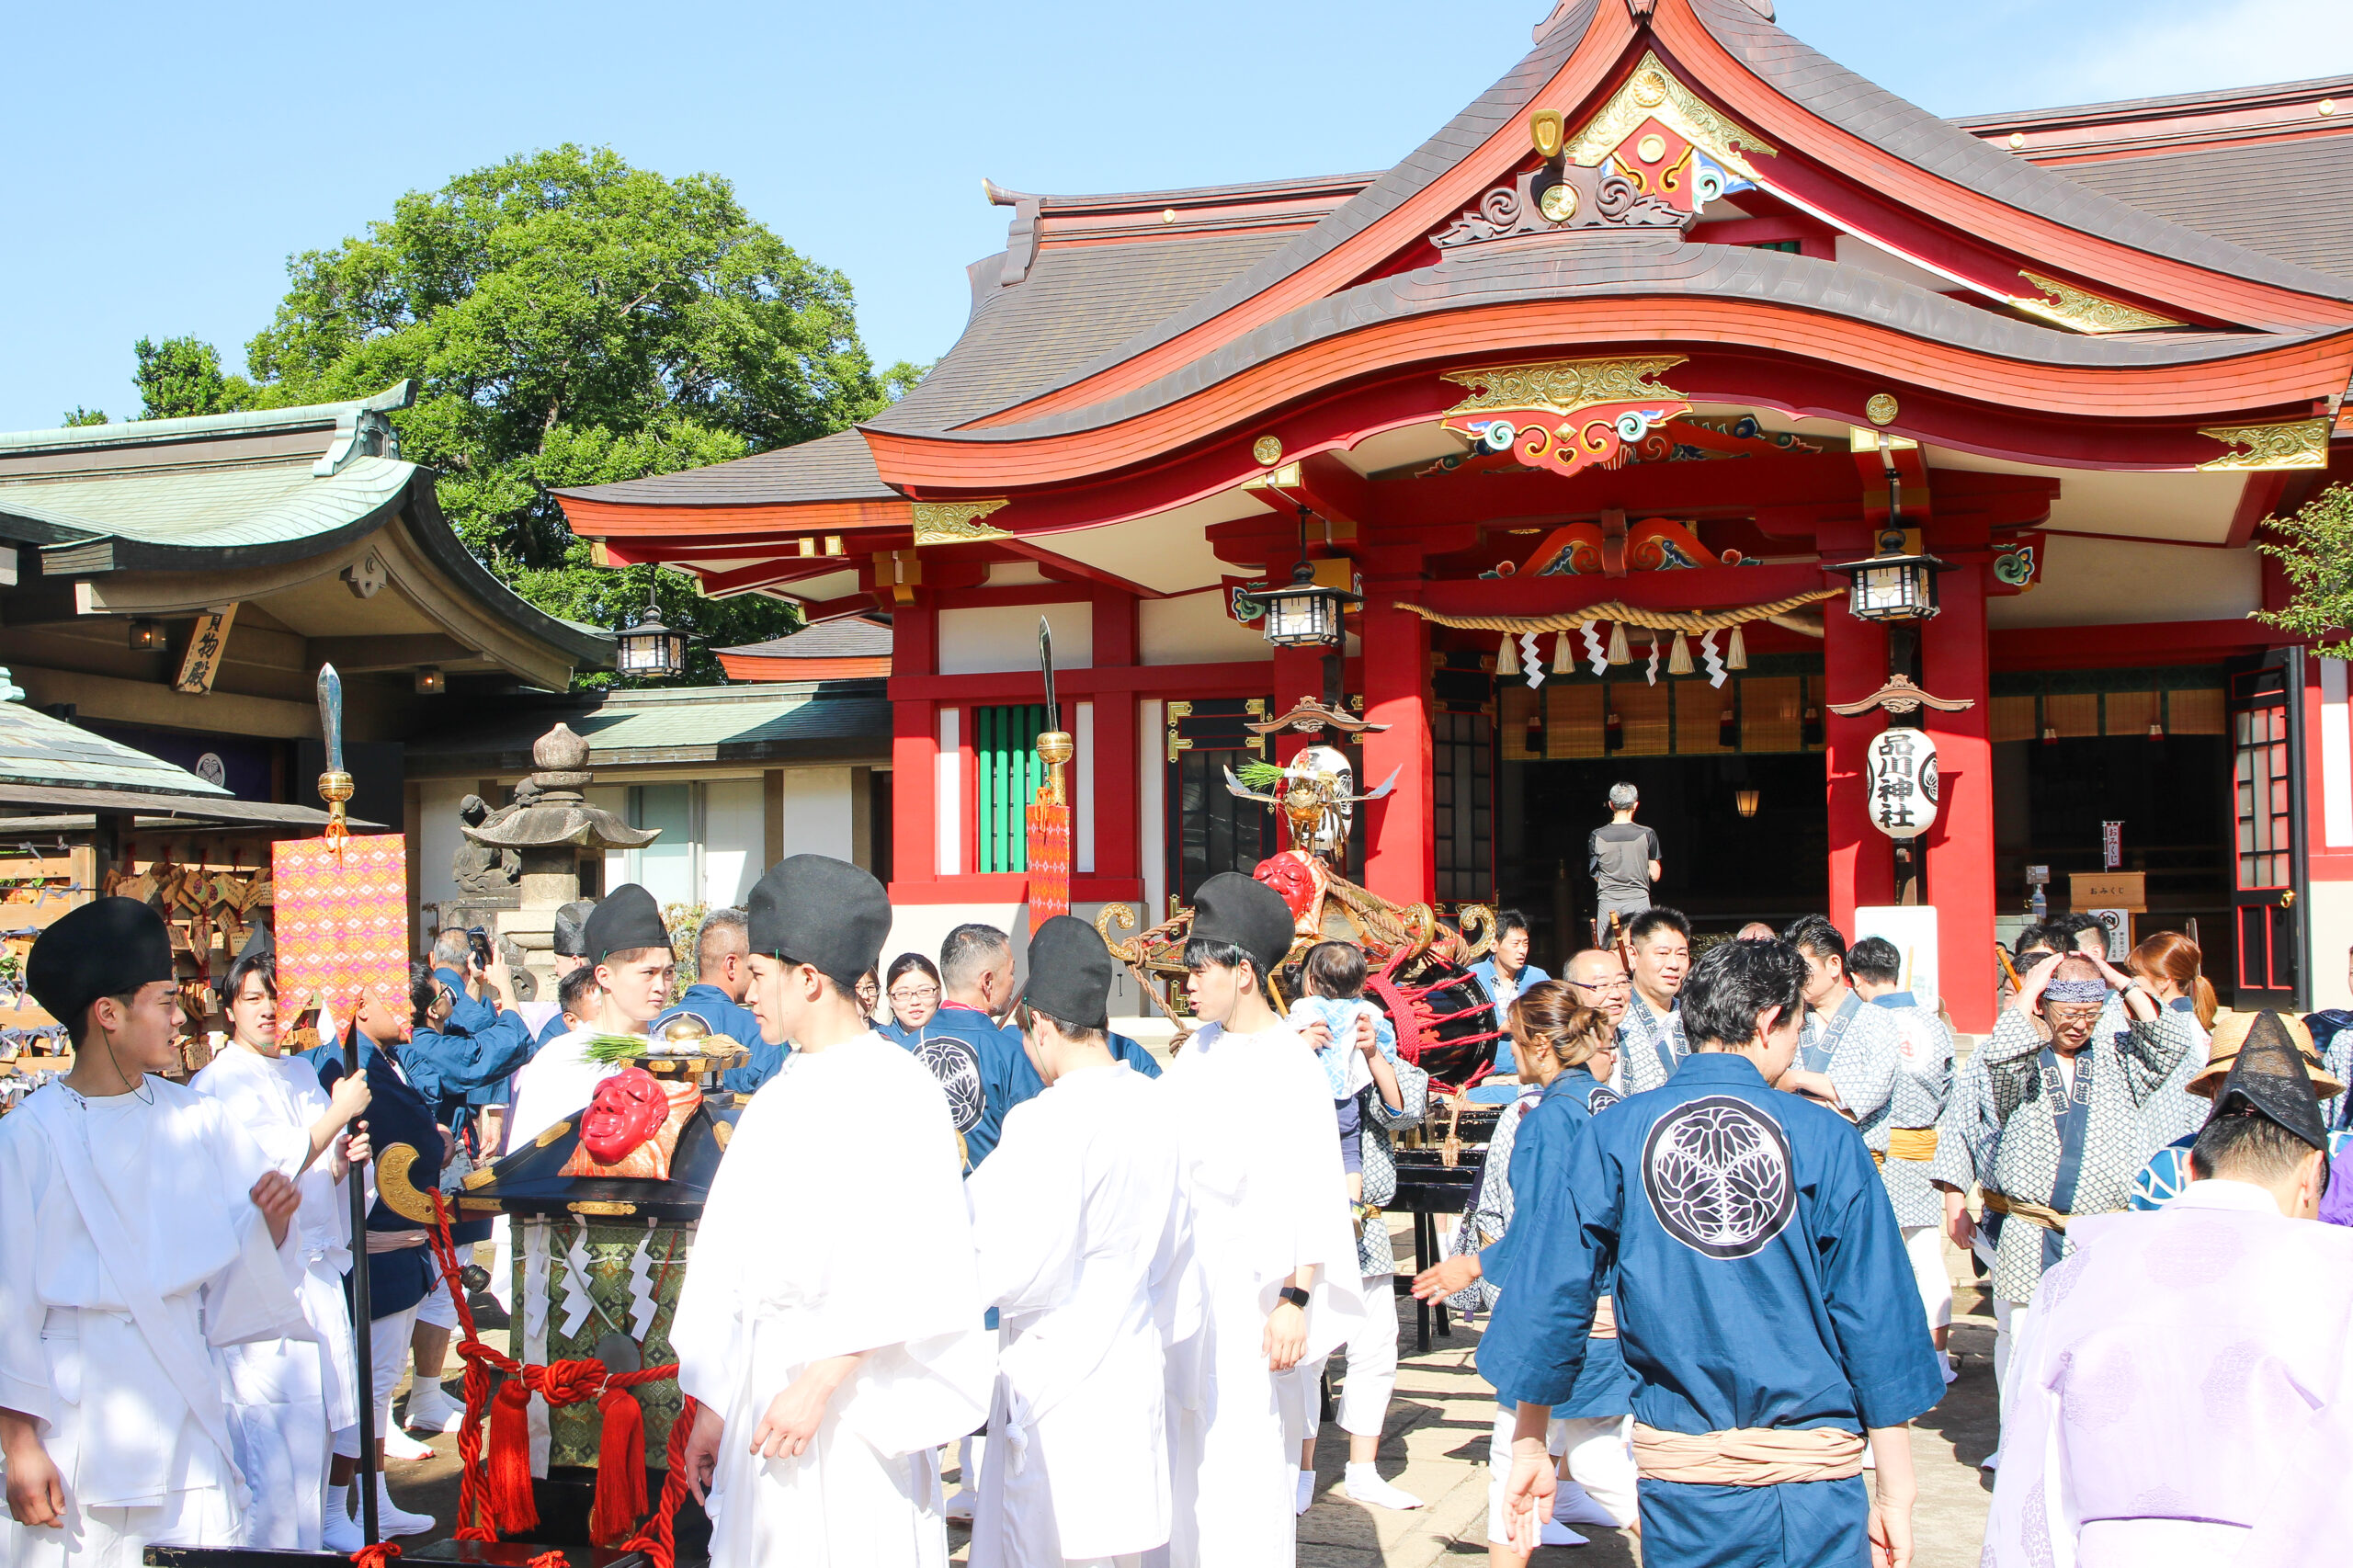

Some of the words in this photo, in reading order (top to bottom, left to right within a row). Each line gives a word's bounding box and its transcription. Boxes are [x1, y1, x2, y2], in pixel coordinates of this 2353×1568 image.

[1877, 733, 1915, 829] 品川神社
[2109, 827, 2118, 864] おみくじ
[2089, 886, 2125, 895] おみくじ
